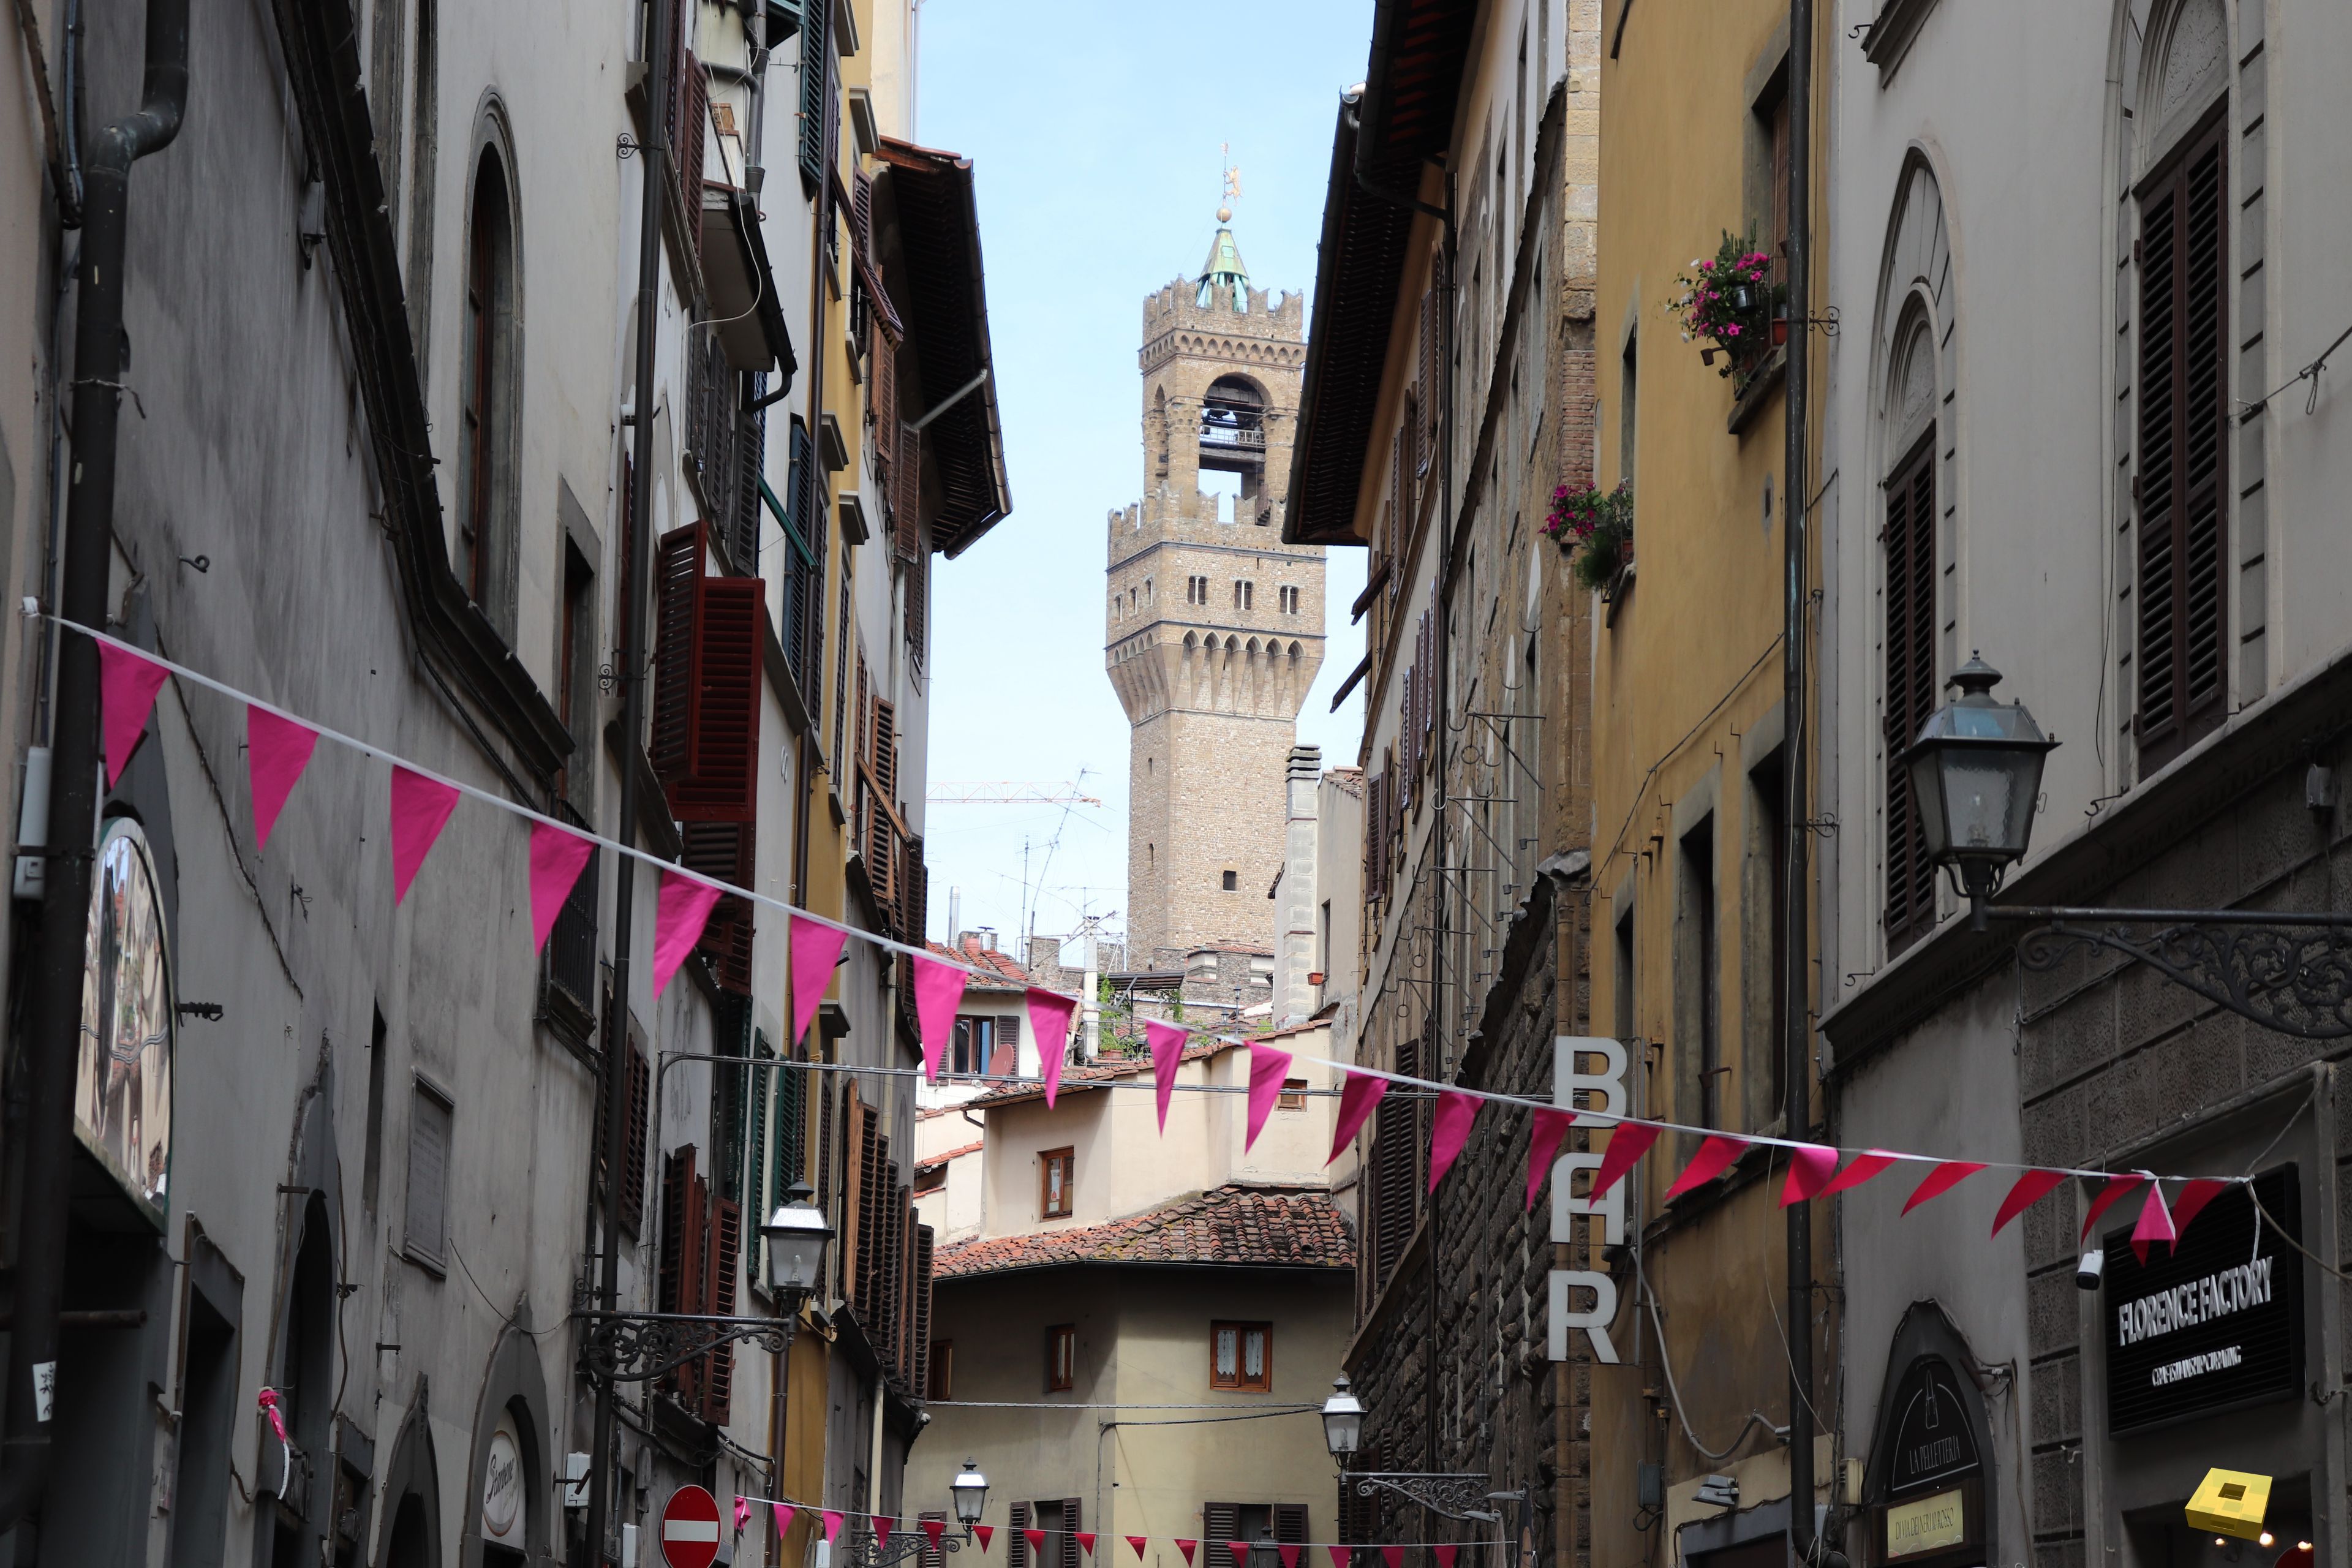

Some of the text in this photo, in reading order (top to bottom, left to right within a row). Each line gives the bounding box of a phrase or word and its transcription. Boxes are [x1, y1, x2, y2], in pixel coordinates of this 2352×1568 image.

[1548, 1035, 1627, 1364] BAR
[2119, 1256, 2272, 1346] FLORENCE FACTORY
[1909, 1434, 1961, 1474] LA PELLETTERIA
[1920, 1512, 1931, 1534] NERI
[1937, 1507, 1954, 1529] ROSSO
